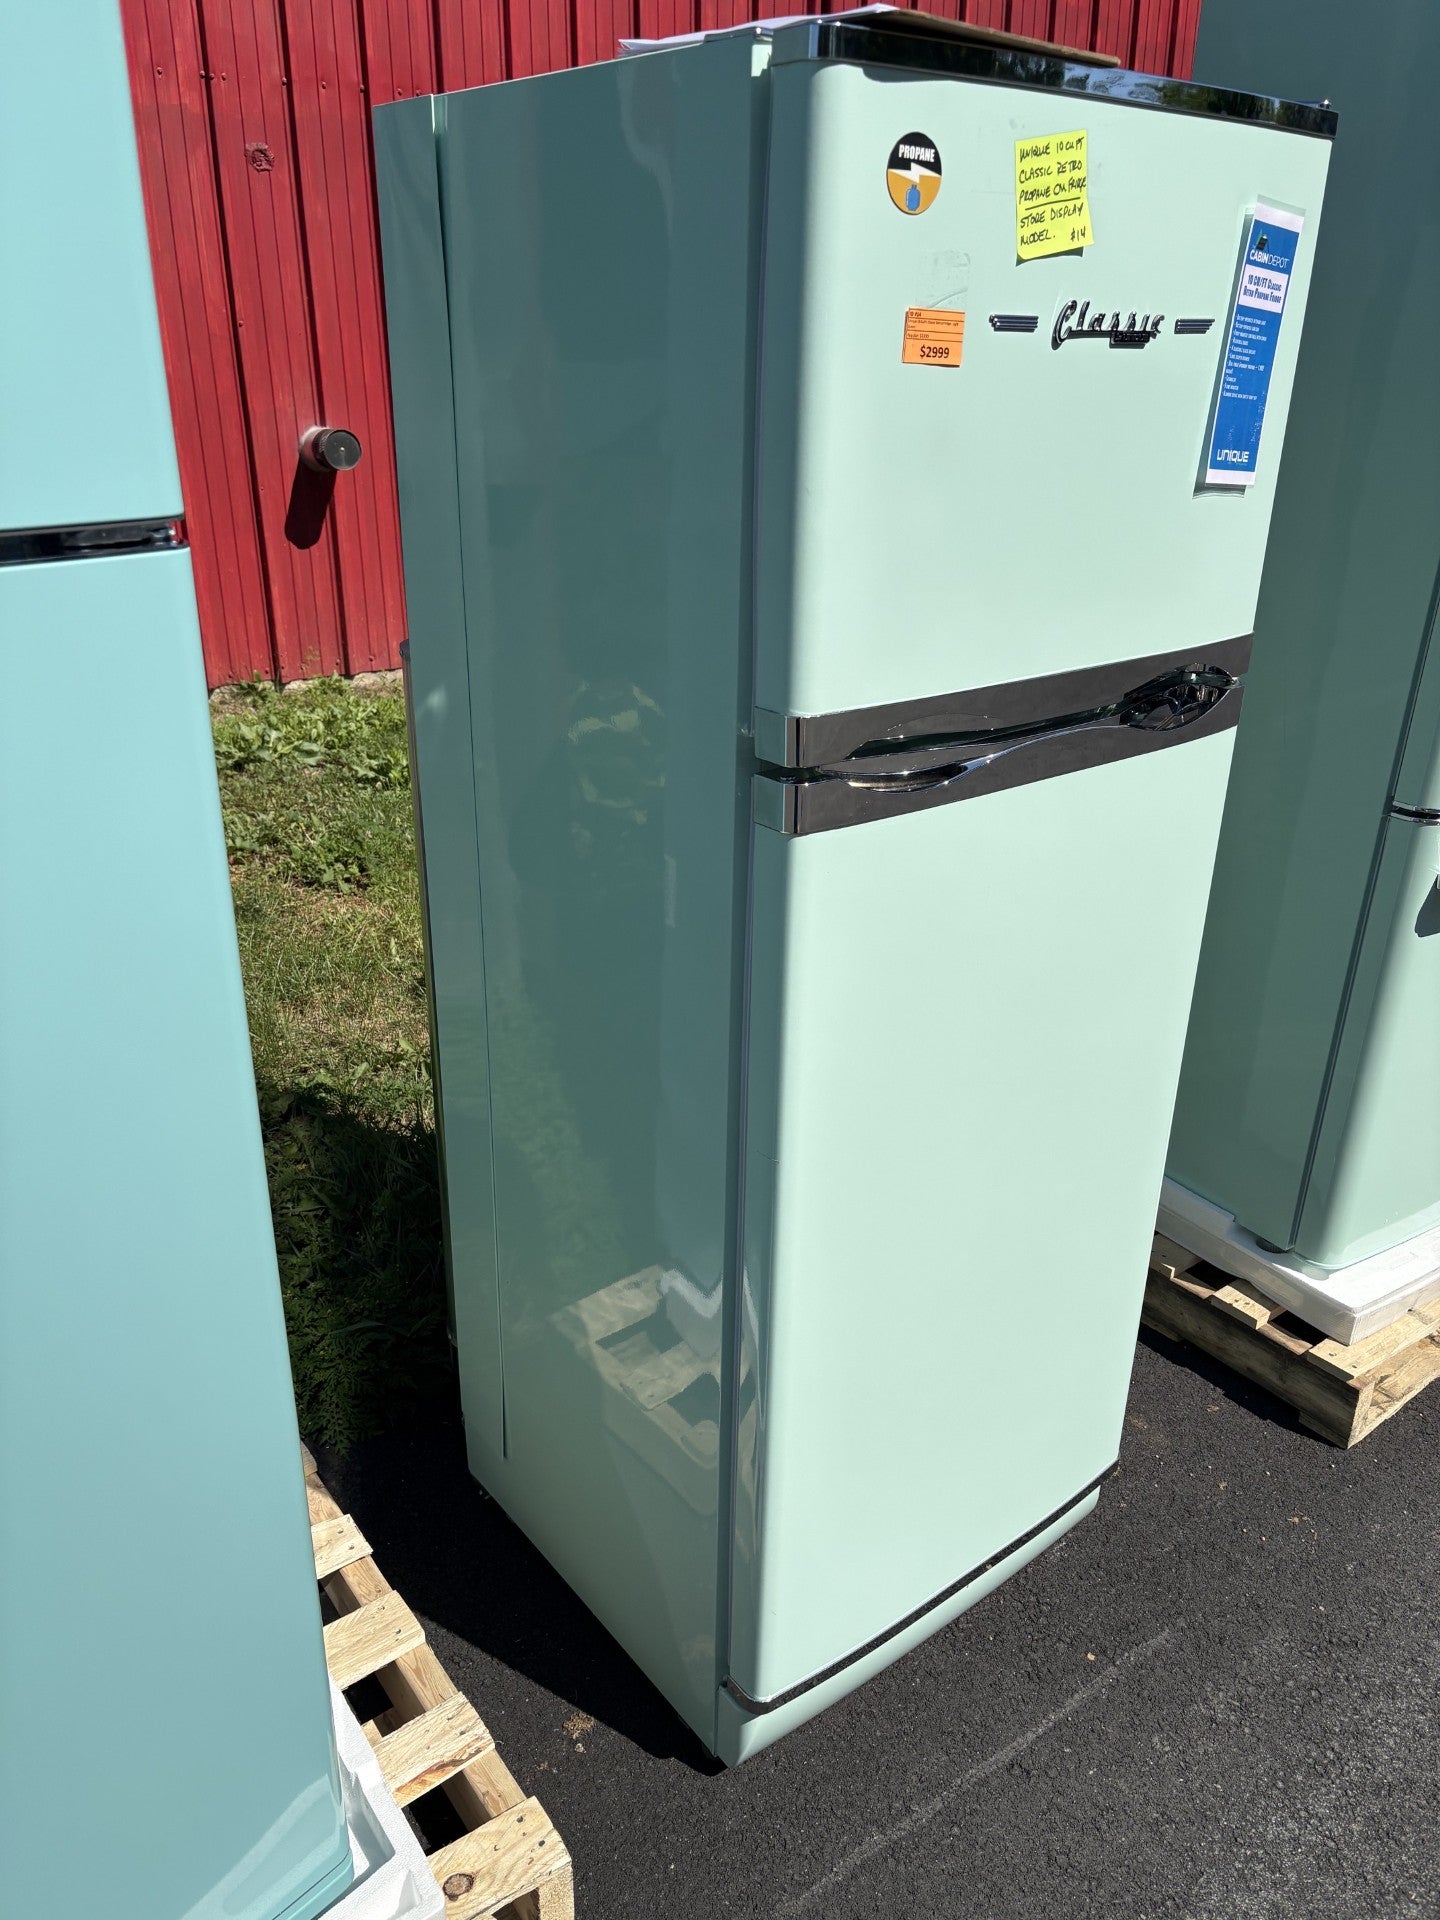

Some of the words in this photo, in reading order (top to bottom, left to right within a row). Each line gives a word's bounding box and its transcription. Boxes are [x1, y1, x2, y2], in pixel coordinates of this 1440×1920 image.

[898, 144, 936, 163] PROPANE
[1019, 143, 1050, 163] UNIQUE
[1056, 141, 1064, 154] 10
[1018, 166, 1052, 184] CLASSIC
[1056, 160, 1082, 176] RETRO
[1018, 188, 1050, 205] PROPANE
[1019, 211, 1045, 229] STORE
[1050, 203, 1083, 221] DISPLAY
[1054, 299, 1165, 345] Classic
[919, 344, 950, 360] $2999
[1216, 448, 1250, 464] UNIQUE
